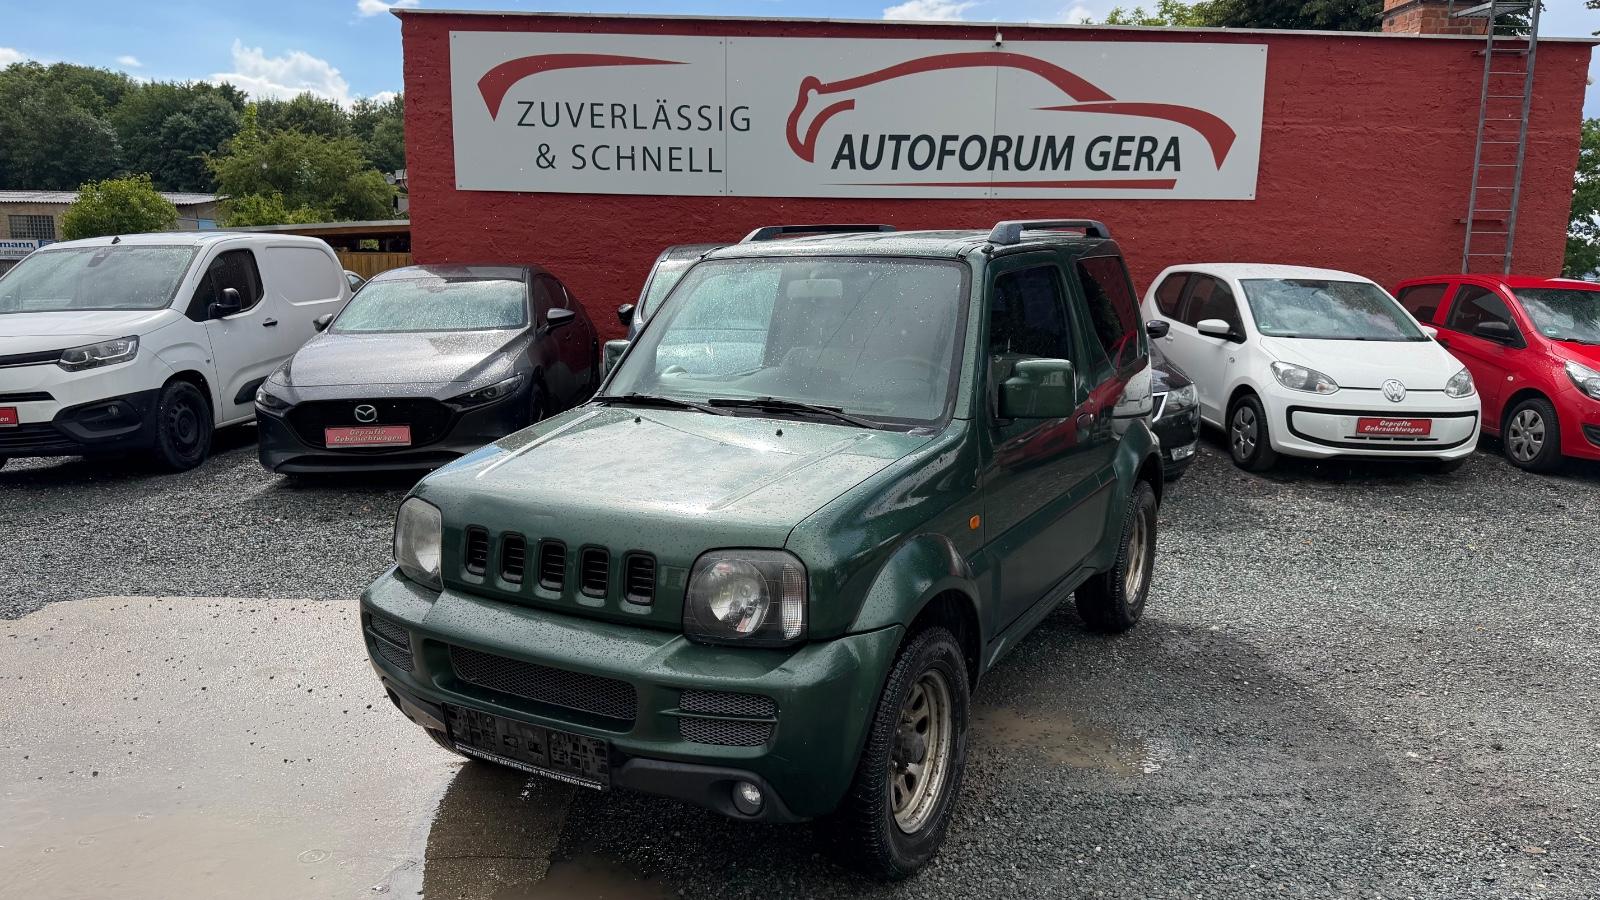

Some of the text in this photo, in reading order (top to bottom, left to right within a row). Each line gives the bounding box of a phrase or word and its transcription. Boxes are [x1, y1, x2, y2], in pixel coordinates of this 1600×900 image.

[517, 99, 751, 132] ZUVERLÄSSIG
[535, 143, 723, 173] & SCHNELL
[831, 134, 1182, 172] AUTOFORUM GERA
[335, 434, 402, 442] Gebrauchtwagen
[1364, 425, 1423, 433] Gebrauchtwagen
